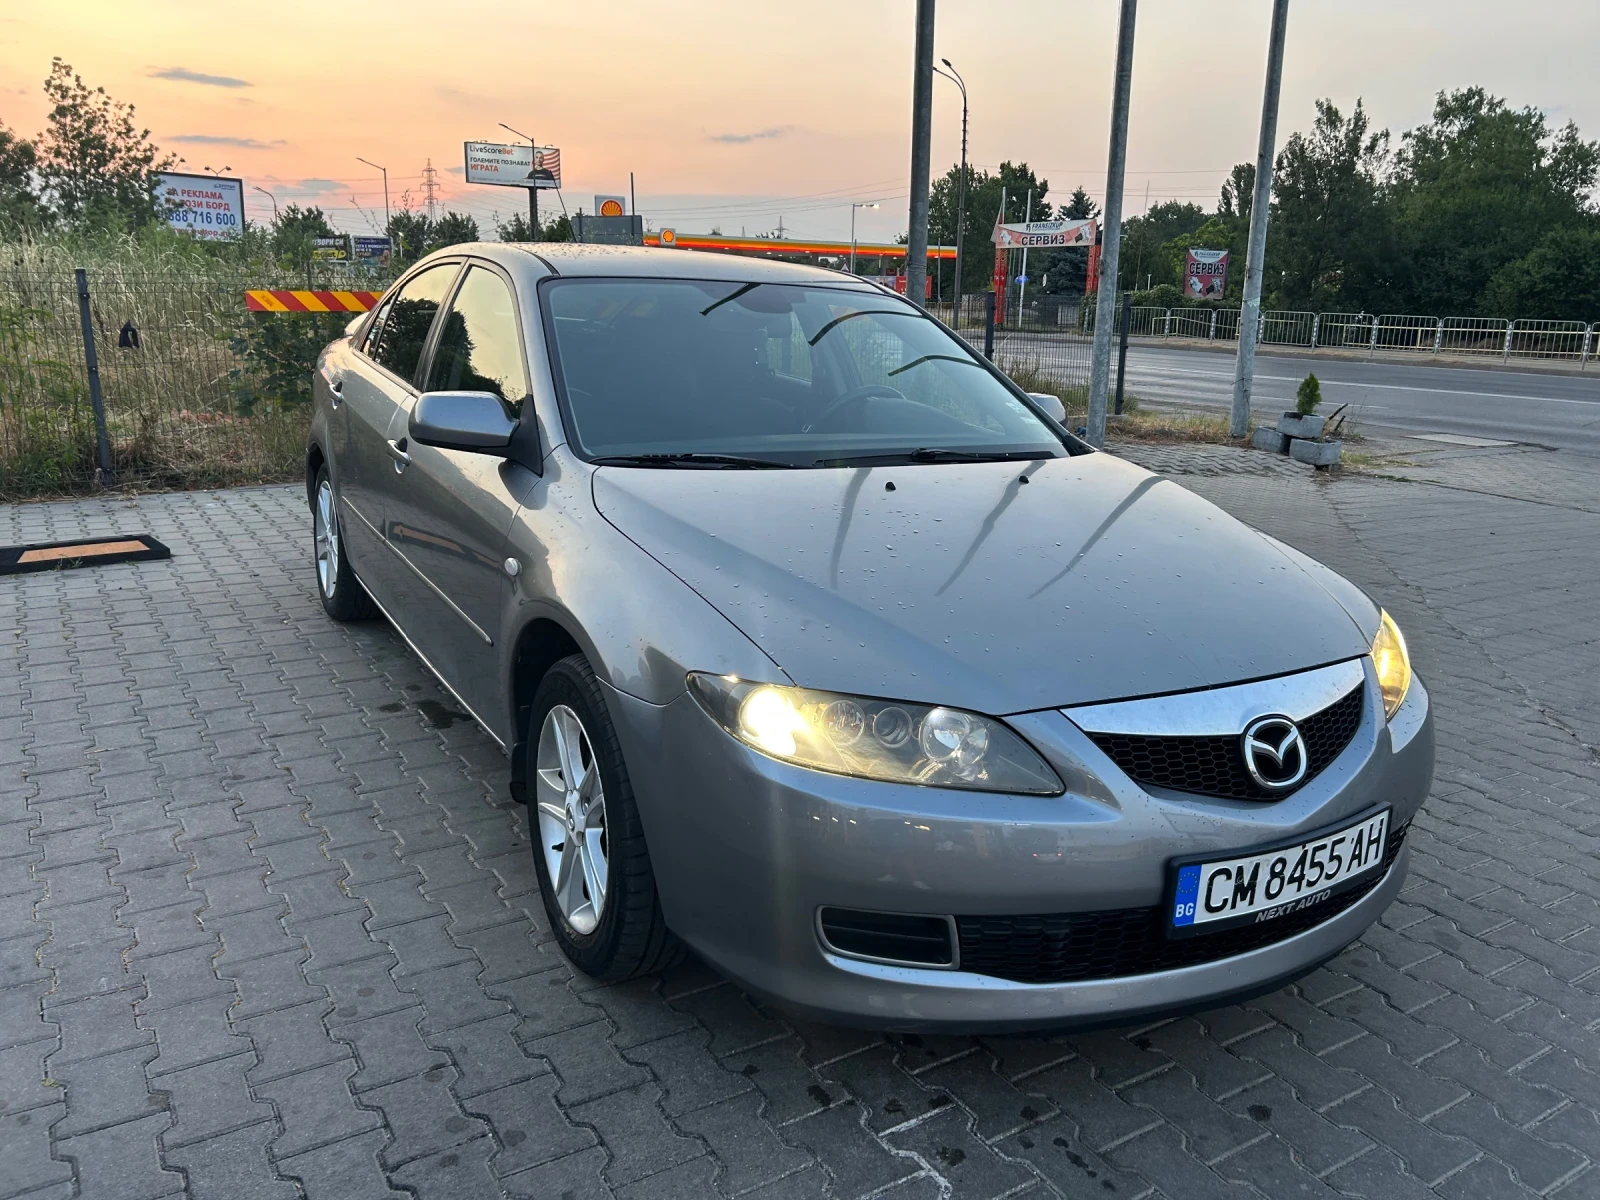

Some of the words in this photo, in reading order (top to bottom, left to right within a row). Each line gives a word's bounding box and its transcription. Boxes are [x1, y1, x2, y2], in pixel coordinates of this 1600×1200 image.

[470, 146, 514, 155] LiveScoreBet
[470, 164, 498, 172] ИГРАТА
[181, 189, 223, 200] РЕКЛАМА
[206, 201, 230, 212] БОРД
[168, 210, 188, 222] 888
[192, 211, 212, 224] 716
[216, 212, 236, 225] 600
[1022, 235, 1065, 245] СЕРВИЗ
[1189, 263, 1224, 275] СЕРВИЗ
[1204, 862, 1260, 914] CM
[1265, 836, 1346, 900] 8455
[1346, 817, 1385, 873] AH
[1175, 902, 1194, 918] BG
[1255, 903, 1295, 923] NEXT
[1296, 889, 1332, 910] AUTO
